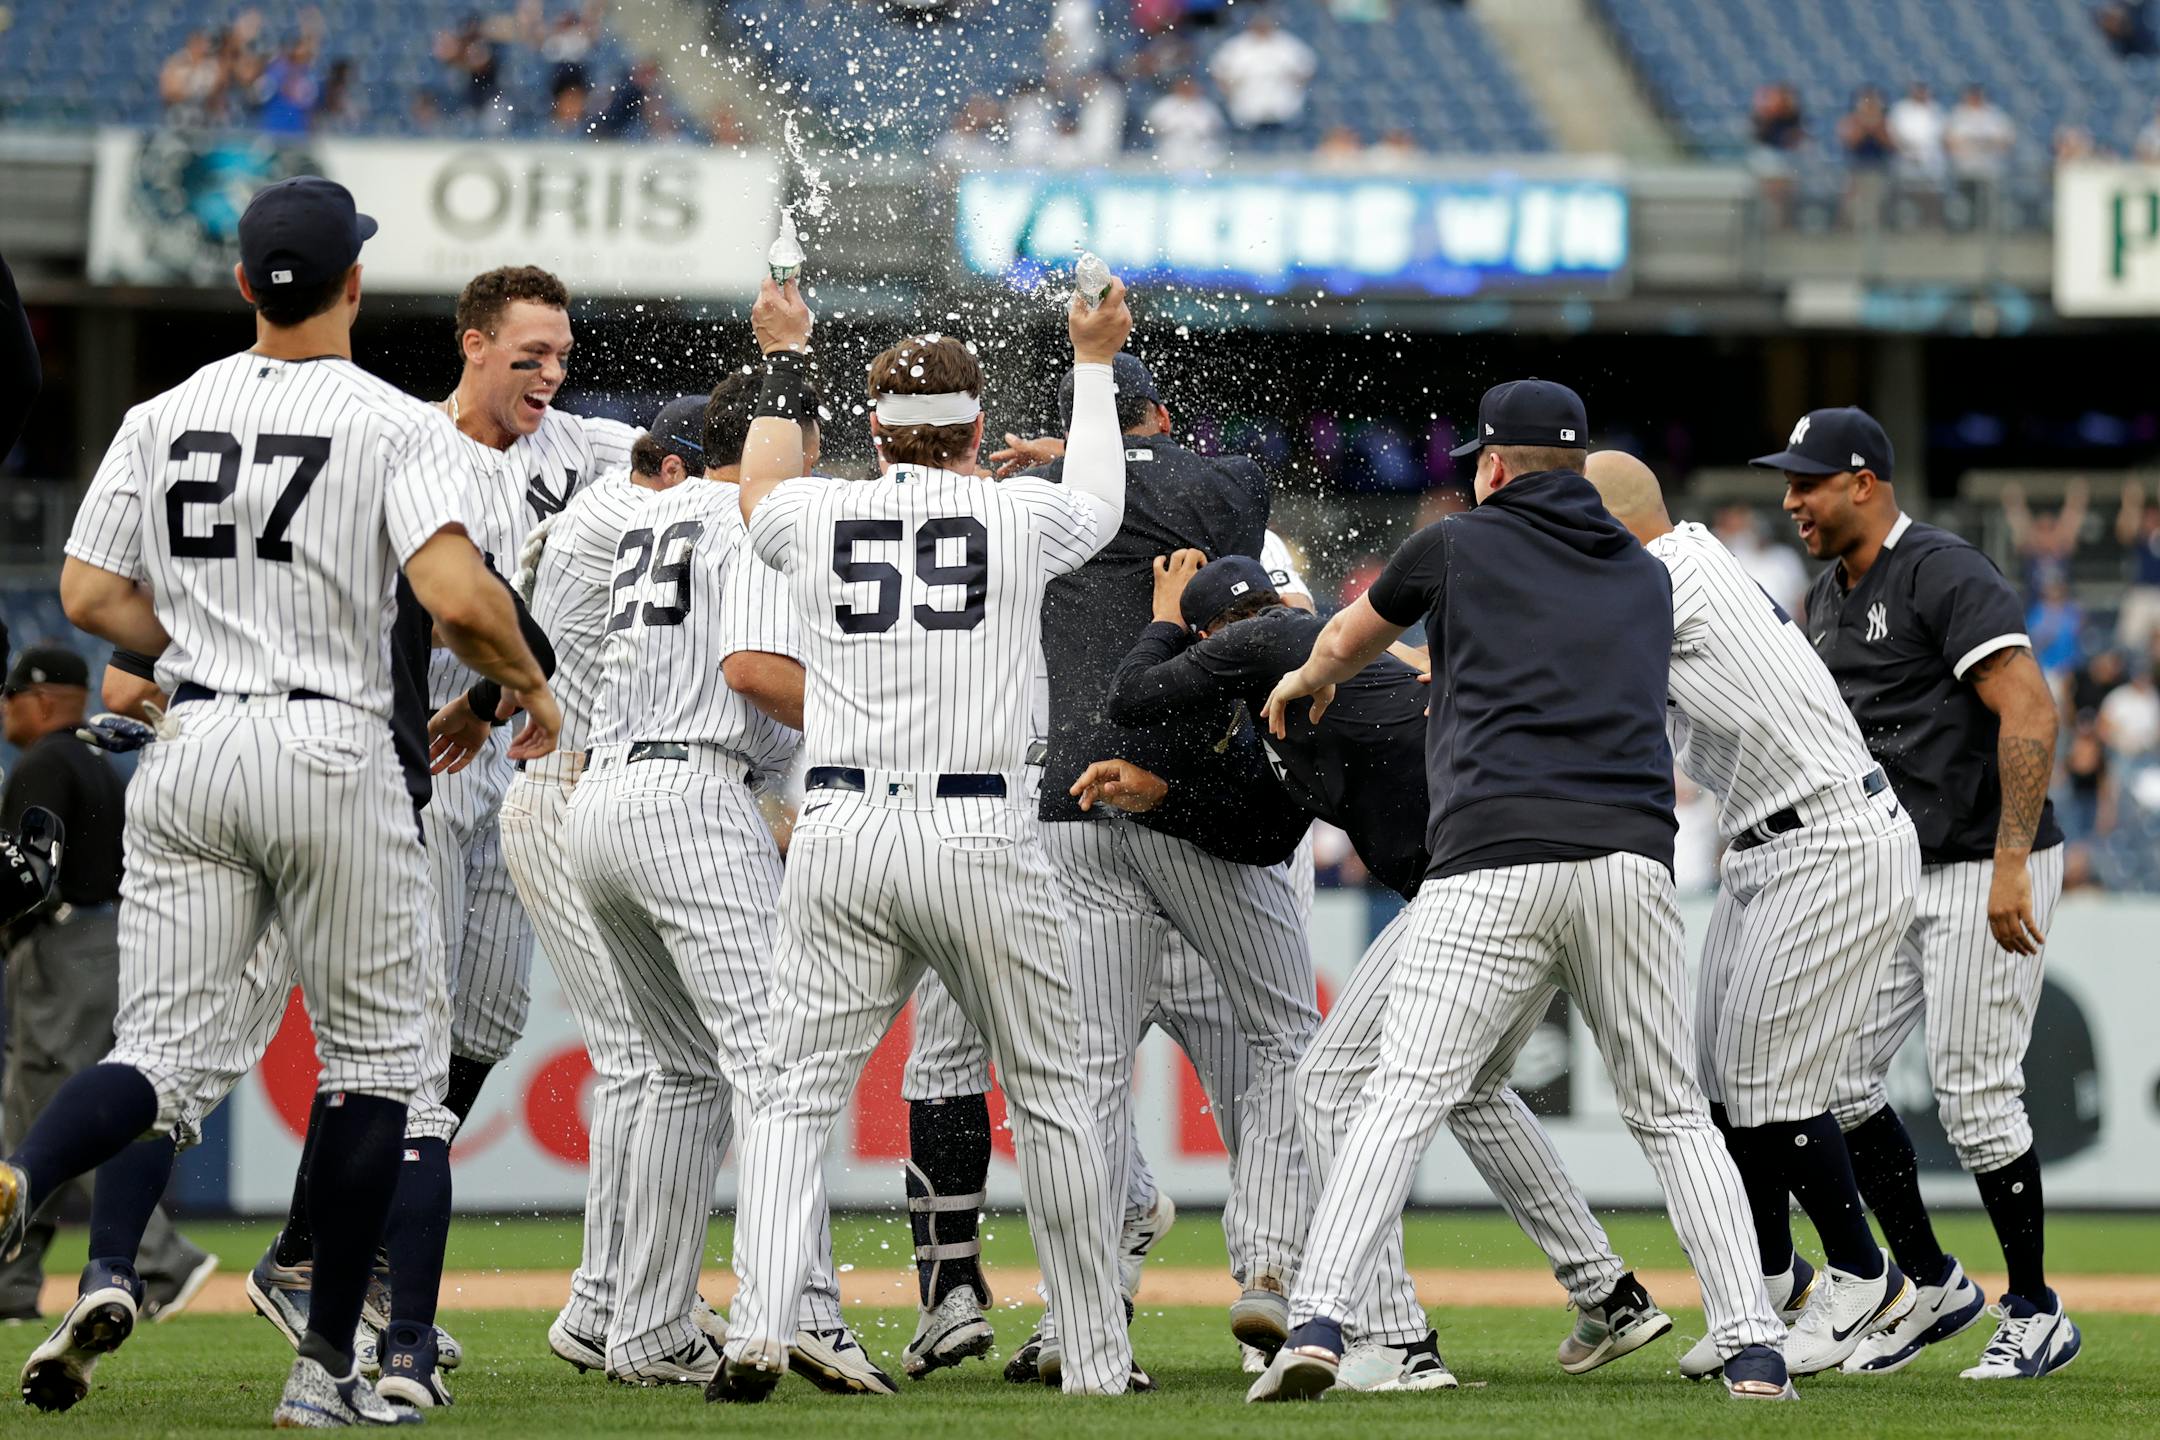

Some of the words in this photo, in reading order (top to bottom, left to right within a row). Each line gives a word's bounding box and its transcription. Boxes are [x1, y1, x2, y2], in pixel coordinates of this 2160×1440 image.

[428, 149, 704, 243] ORIS
[165, 430, 333, 564] 27
[605, 520, 705, 635] 29
[832, 516, 988, 635] 59
[5, 845, 26, 868] 24
[391, 1353, 414, 1369] 66
